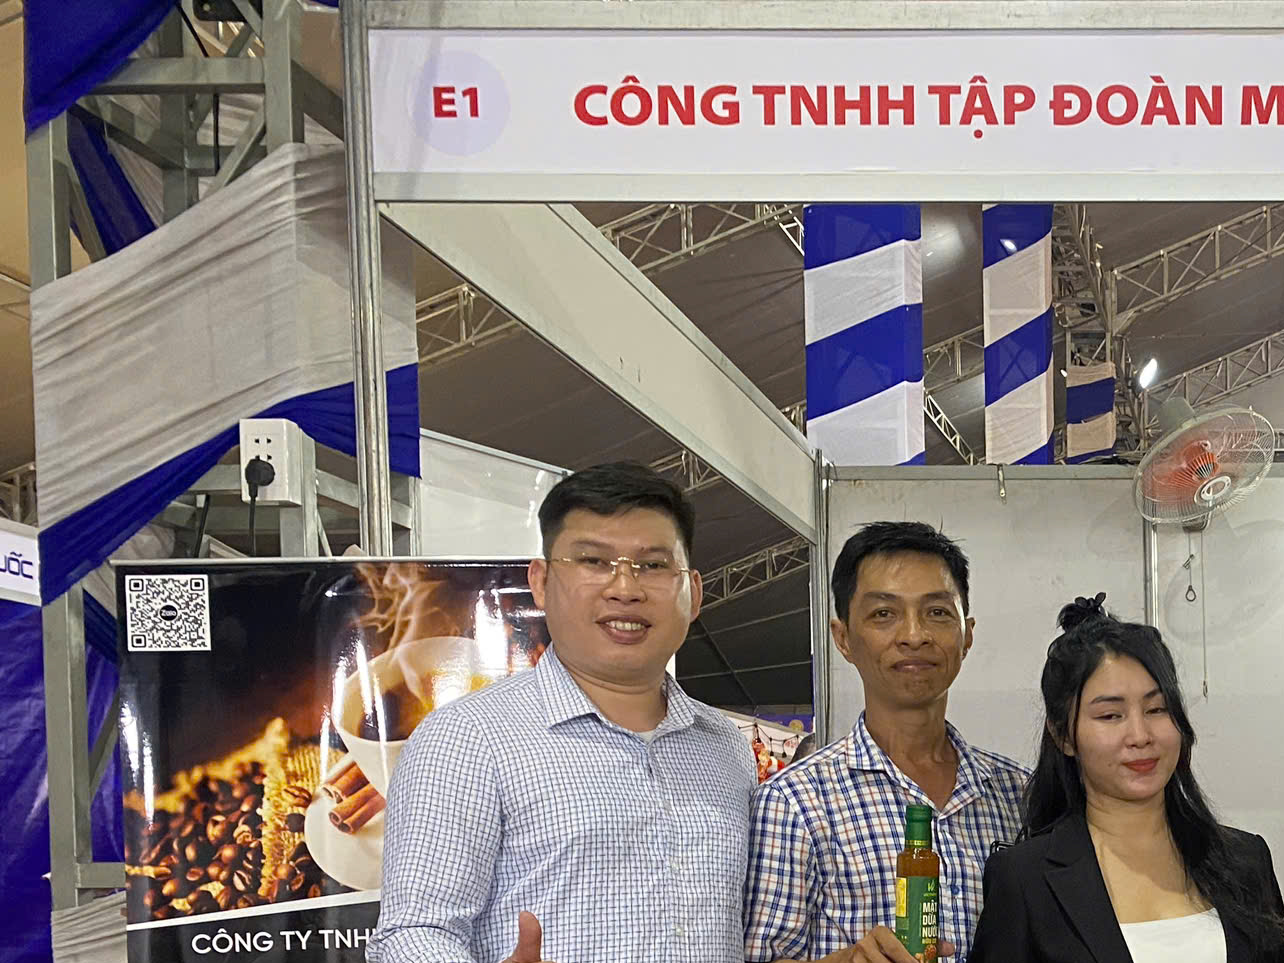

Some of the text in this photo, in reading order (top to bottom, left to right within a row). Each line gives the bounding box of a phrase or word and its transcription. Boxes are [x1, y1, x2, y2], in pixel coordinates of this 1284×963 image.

[431, 86, 480, 119] E1
[573, 74, 741, 127] CÔNG
[751, 84, 915, 127] TNHH
[927, 75, 1036, 139] TẬP
[1049, 74, 1224, 127] ĐOÀN
[191, 928, 379, 954] CÔNG TY TNH
